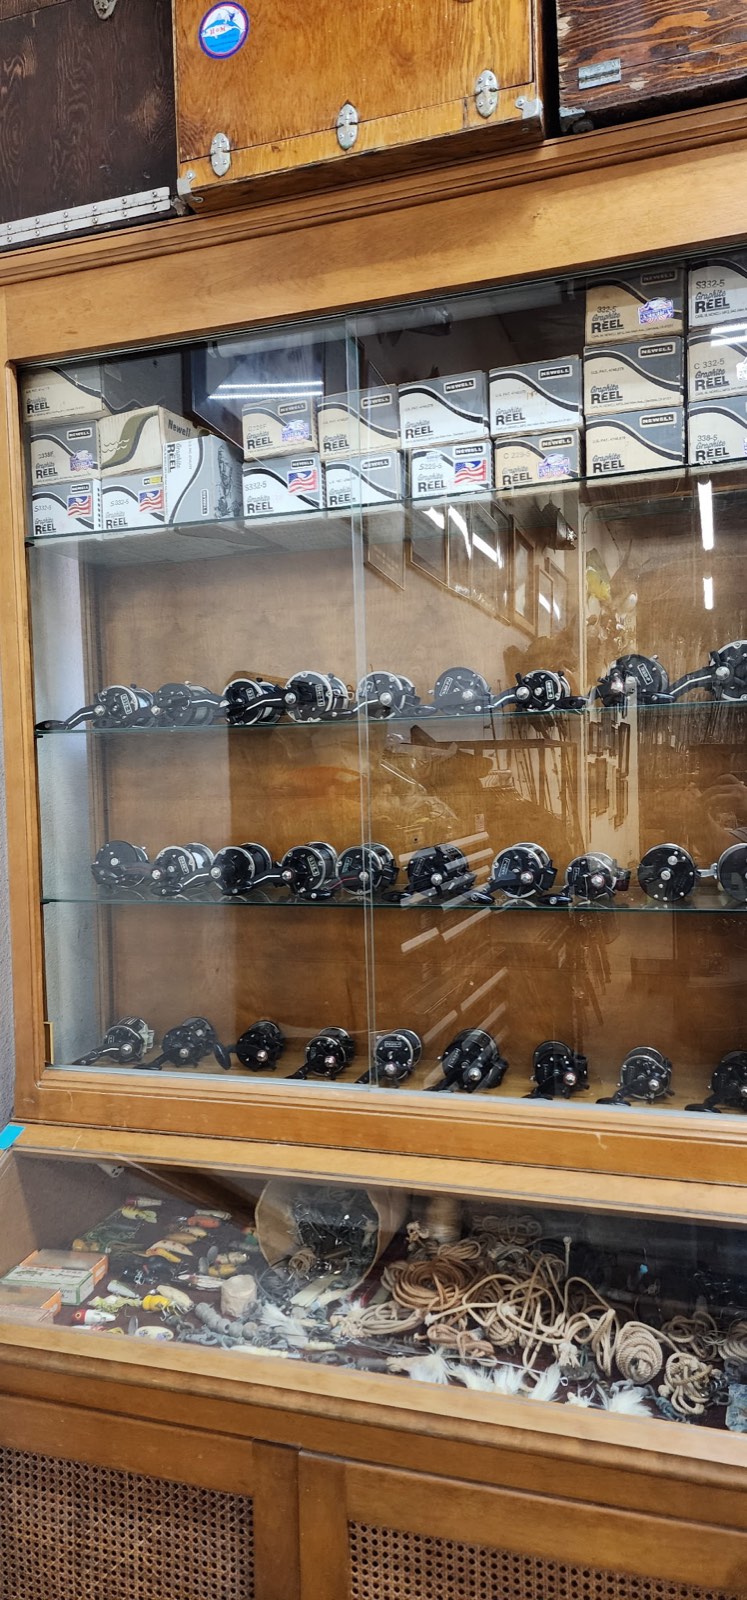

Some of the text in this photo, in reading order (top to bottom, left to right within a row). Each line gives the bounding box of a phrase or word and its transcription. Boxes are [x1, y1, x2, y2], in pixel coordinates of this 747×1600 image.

[643, 273, 673, 282] NEWELL
[696, 279, 725, 289] S332-5
[696, 290, 726, 300] Graphite
[695, 297, 730, 313] REEL
[592, 312, 620, 321] Graphite
[592, 319, 624, 333] REEL
[641, 345, 673, 355] NEWELL
[694, 358, 725, 370] C 332-5
[541, 367, 570, 377] NEWELL
[695, 368, 725, 379] Graphite
[446, 381, 474, 390] NEWELL
[590, 384, 619, 393] Graphite
[695, 376, 730, 391] REEL
[591, 391, 623, 404] REEL
[27, 401, 50, 414] REEL
[496, 407, 522, 416] Graphite
[496, 412, 526, 426] REEL
[642, 415, 673, 424] NEWELL
[168, 419, 191, 437] Newell
[405, 425, 434, 439] REEL
[247, 437, 273, 450] REEL
[324, 440, 350, 452] REEL
[542, 438, 571, 447] NEWELL
[696, 440, 726, 449] Graphite
[167, 444, 176, 474] REEL
[592, 453, 620, 462] Graphite
[696, 447, 730, 461] REEL
[593, 460, 624, 473] REEL
[36, 468, 58, 480] REEL
[503, 472, 533, 485] REEL
[418, 480, 447, 492] REEL
[247, 503, 273, 515] REEL
[35, 523, 57, 535] REEL
[106, 518, 128, 529] REEL
